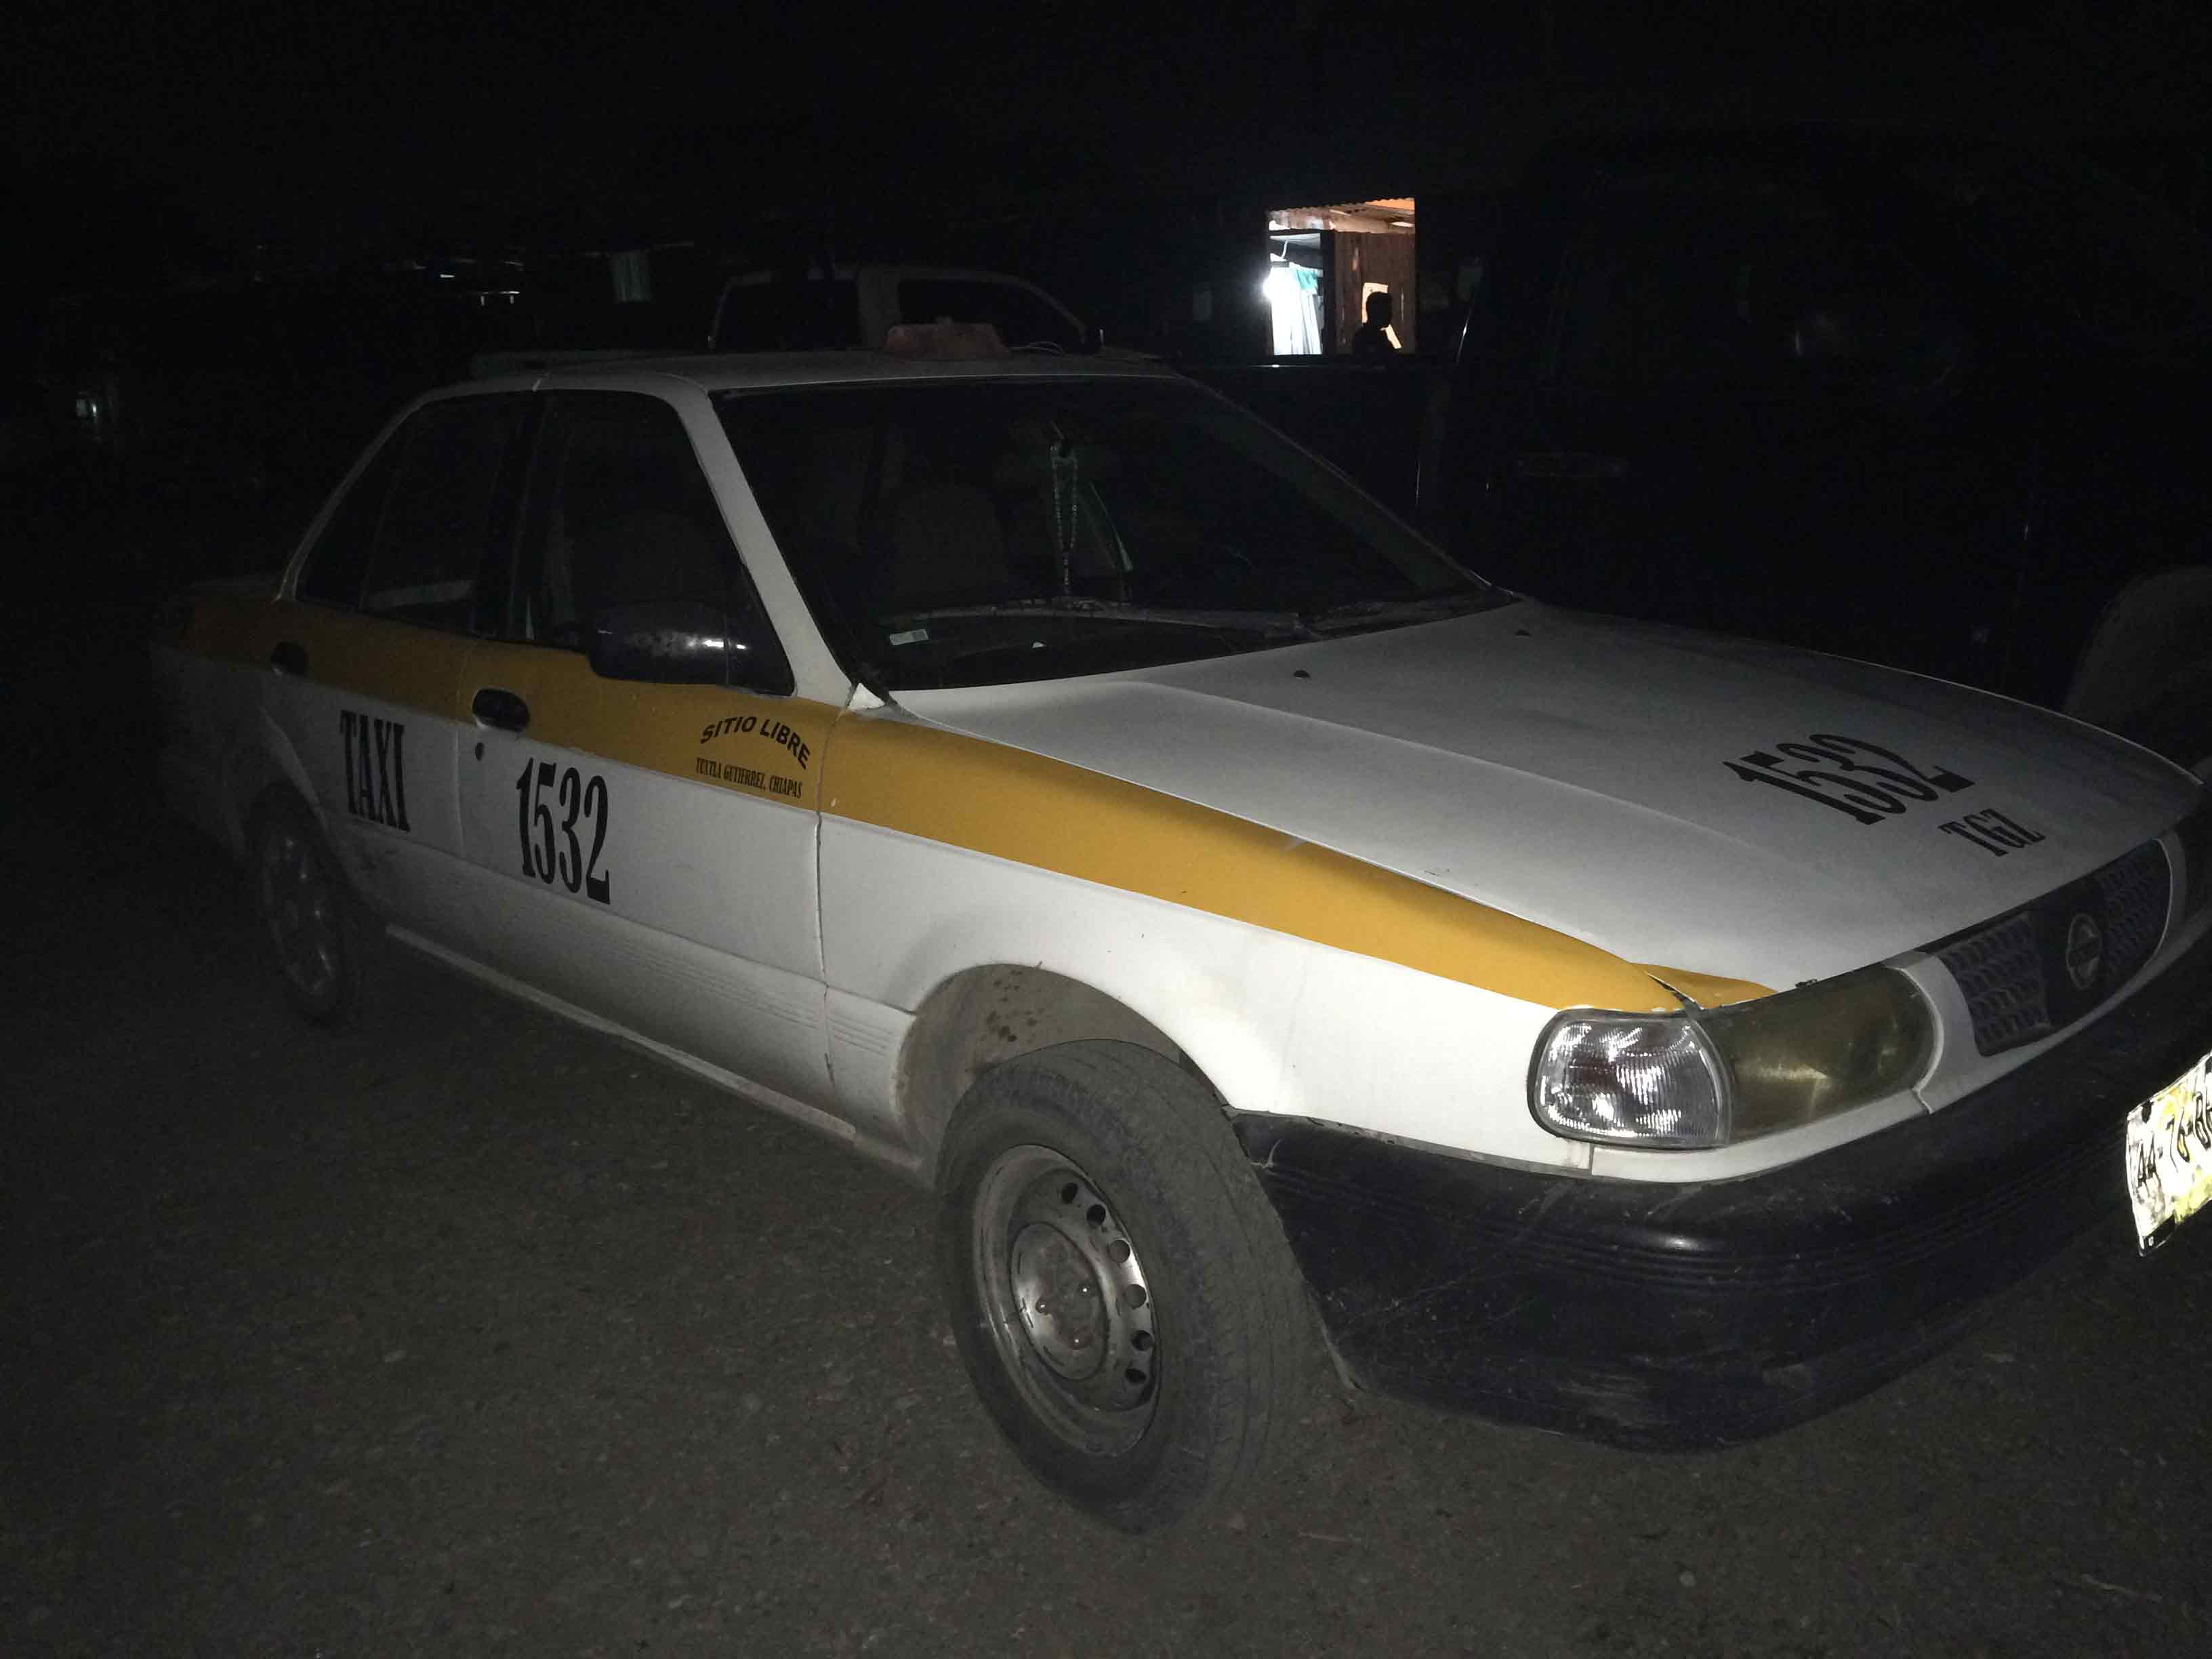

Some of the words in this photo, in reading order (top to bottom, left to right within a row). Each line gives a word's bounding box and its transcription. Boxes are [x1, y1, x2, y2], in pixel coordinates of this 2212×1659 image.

[340, 710, 411, 832] TAXI
[700, 716, 758, 745] SITIO
[759, 718, 811, 771] LIBRE
[1721, 733, 1975, 826] 1532
[769, 775, 803, 799] CHIAPAS
[515, 756, 611, 905] 1532
[1937, 808, 2046, 857] TGZ
